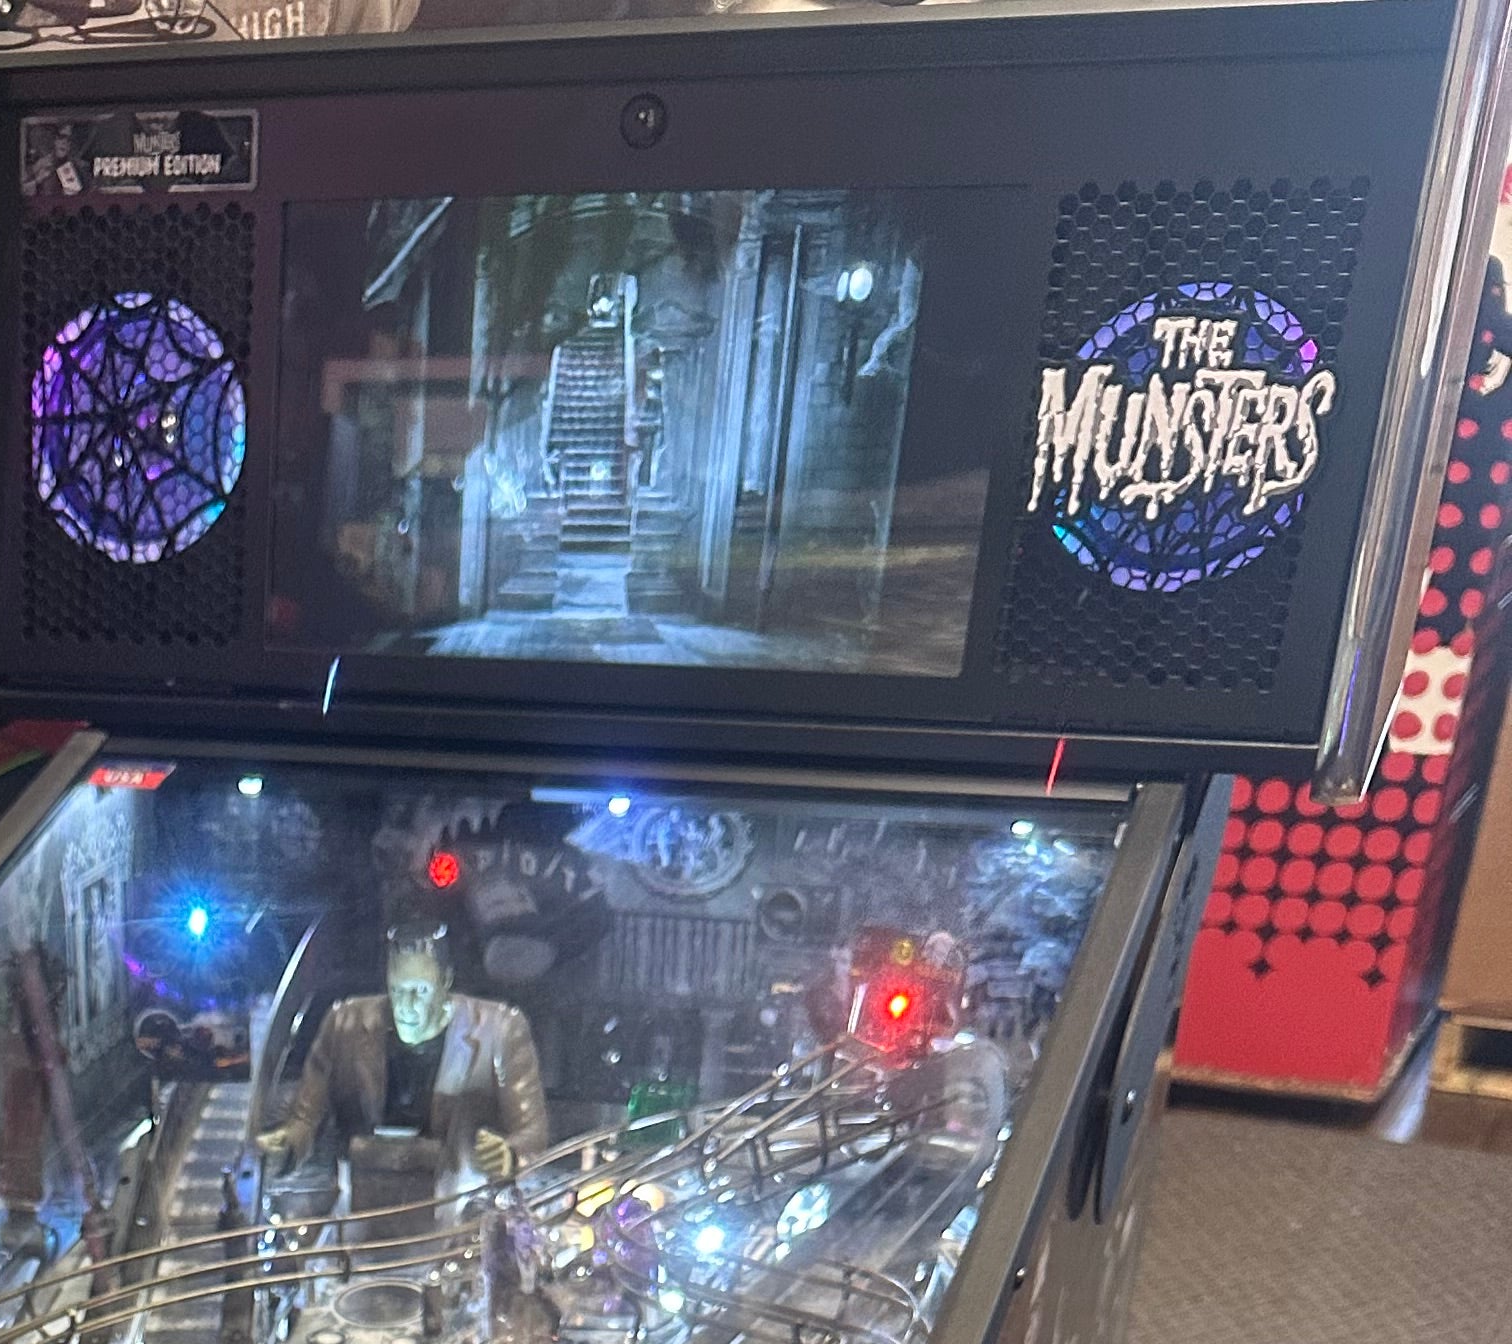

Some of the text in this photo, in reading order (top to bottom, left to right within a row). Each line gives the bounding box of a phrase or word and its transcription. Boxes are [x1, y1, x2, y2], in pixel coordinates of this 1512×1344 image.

[94, 153, 221, 176] PREMIUM EDITION
[1153, 315, 1239, 369] THE
[1026, 364, 1337, 522] MUNSTERS
